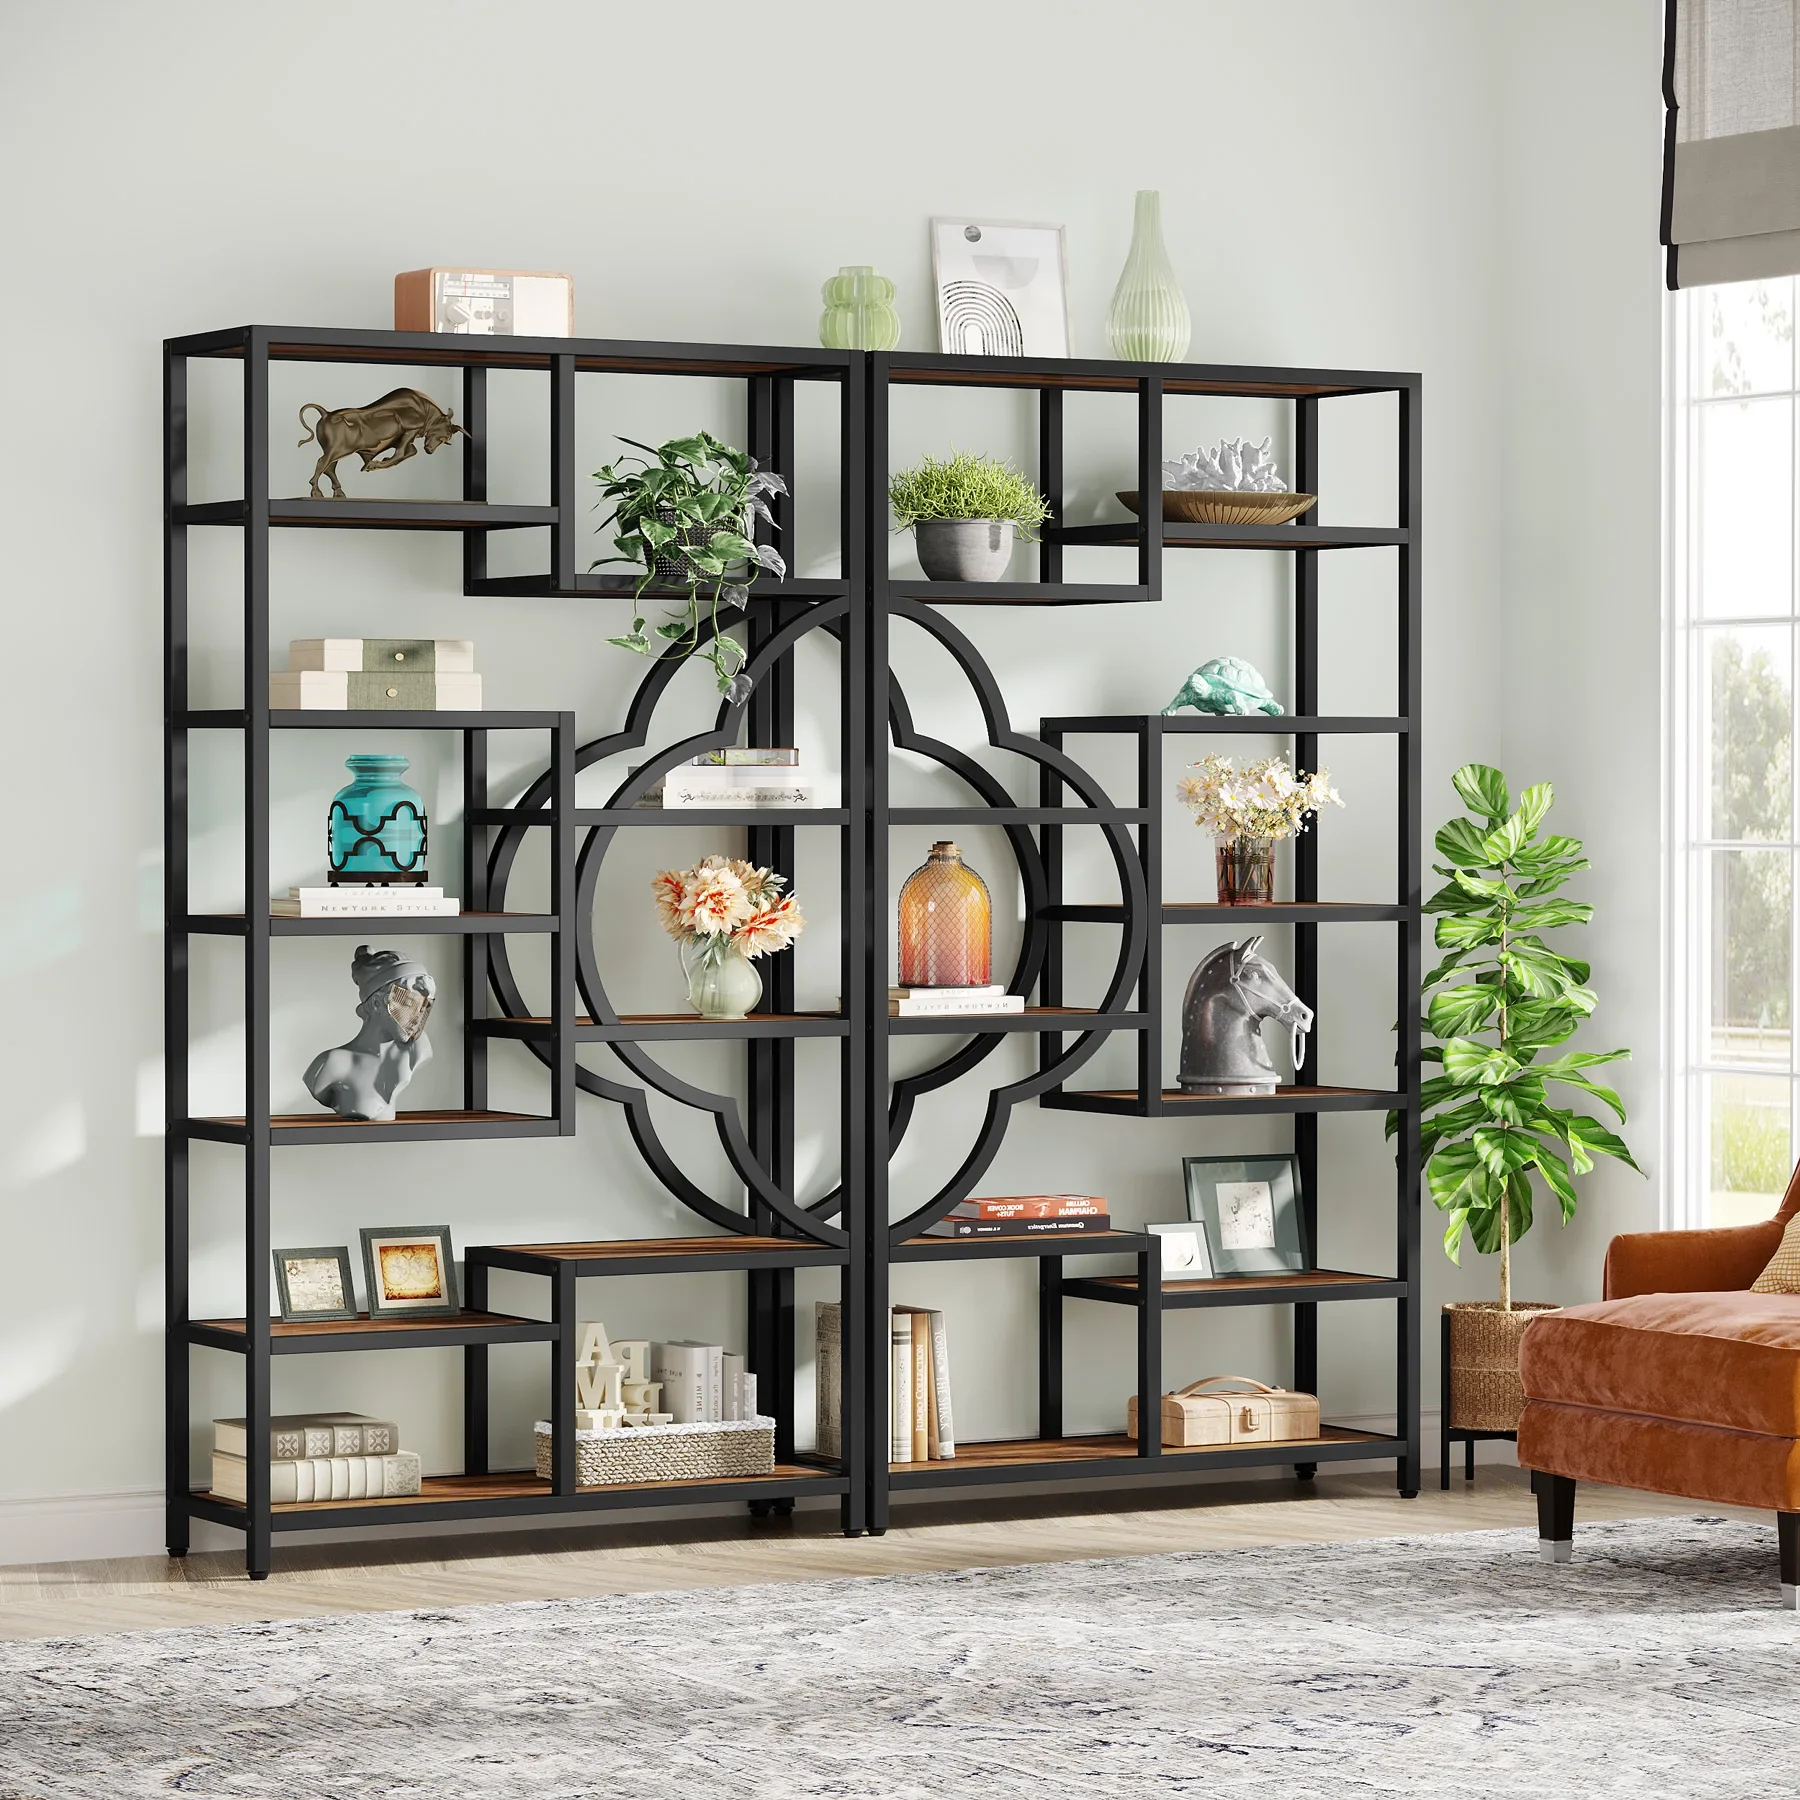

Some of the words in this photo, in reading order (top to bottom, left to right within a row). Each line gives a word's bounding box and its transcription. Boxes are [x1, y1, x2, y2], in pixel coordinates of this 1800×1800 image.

[934, 1328, 945, 1366] YOUNG
[915, 1344, 925, 1400] COLLECTION
[936, 1375, 947, 1395] THE
[915, 1401, 925, 1432] JUMBO
[938, 1396, 951, 1431] SHACK
